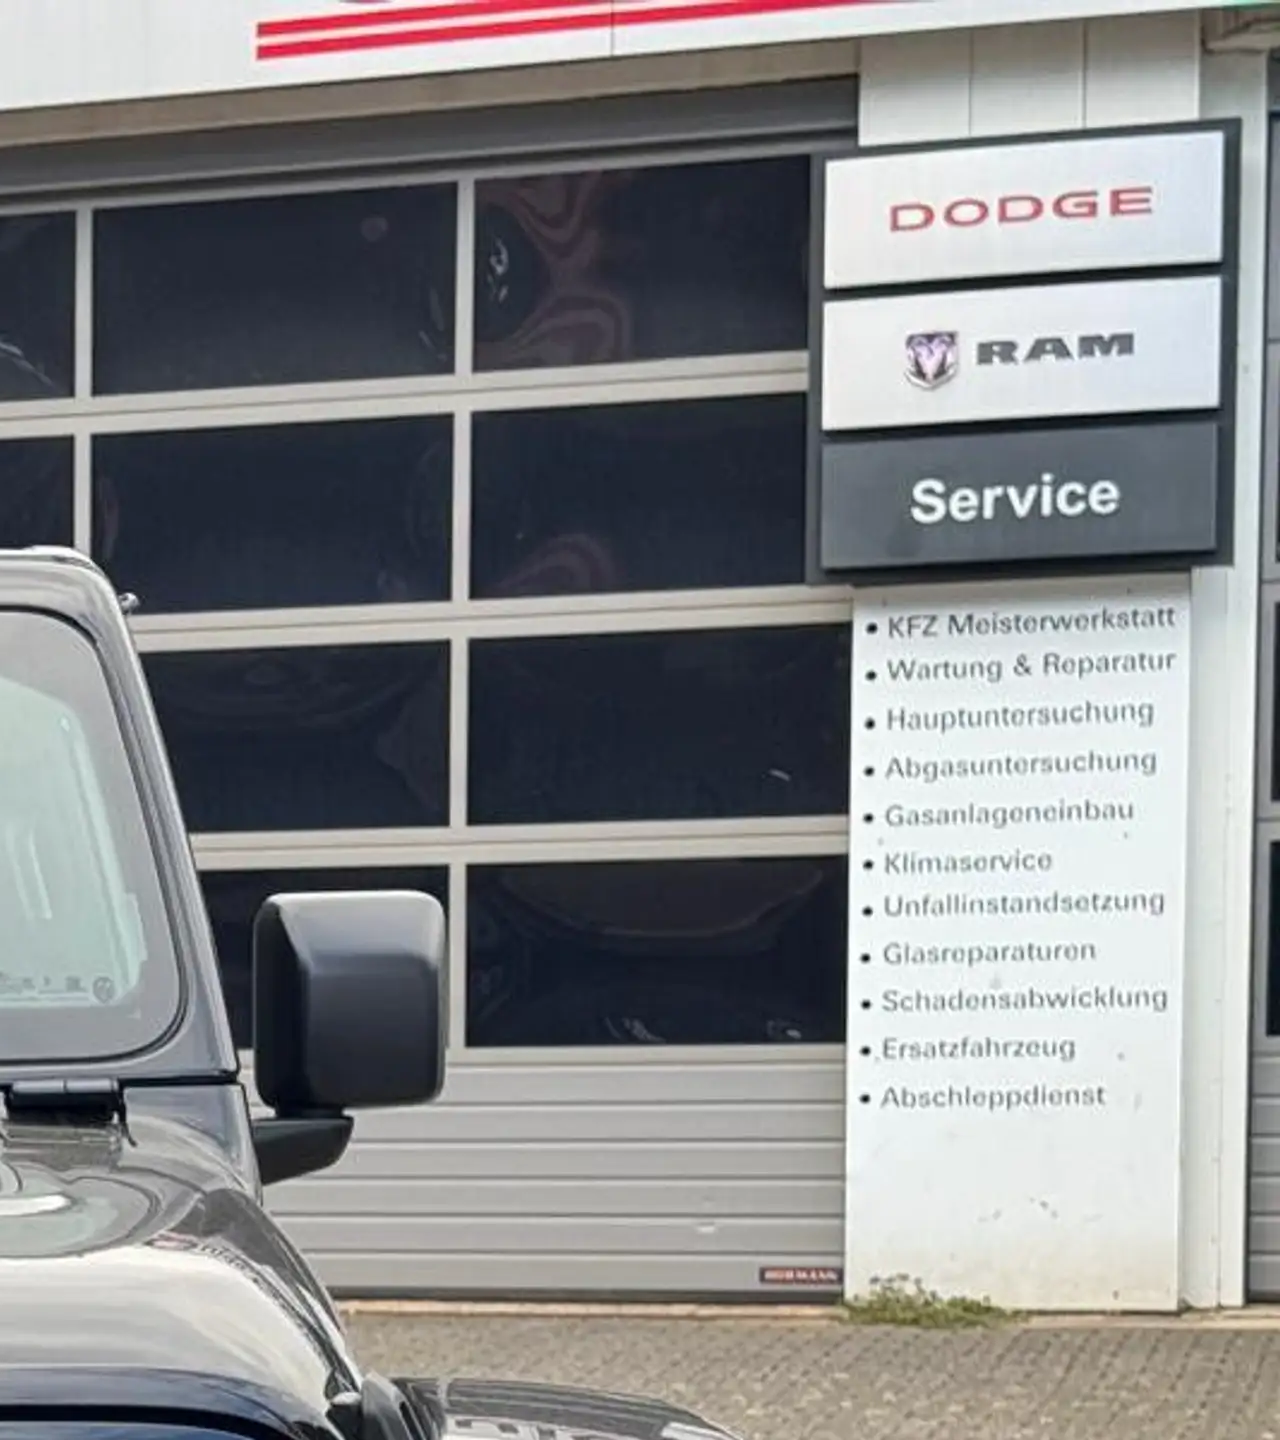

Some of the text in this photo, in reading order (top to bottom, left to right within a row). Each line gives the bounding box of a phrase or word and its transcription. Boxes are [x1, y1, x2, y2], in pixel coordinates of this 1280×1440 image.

[889, 186, 1154, 233] DODGE
[976, 332, 1135, 366] RAM
[910, 473, 1121, 524] Service
[887, 606, 1178, 639] KFZ Meisterwerkstatt
[887, 650, 1178, 684] Wartung & Reparatur
[886, 701, 1156, 734] Hauptuntersuchung
[885, 750, 1158, 783] Abgasuntersuchung
[884, 798, 1135, 830] Gasanlageneinbau
[883, 849, 1053, 875] Klimaservice
[883, 892, 1166, 917] Unfallinstandsetzung
[882, 941, 1097, 968] Glasreparaturen
[881, 985, 1169, 1014] Schadensabwicklung
[881, 1036, 1077, 1063] Ersatzfahrzeug
[879, 1084, 1107, 1113] Abschleppdienst
